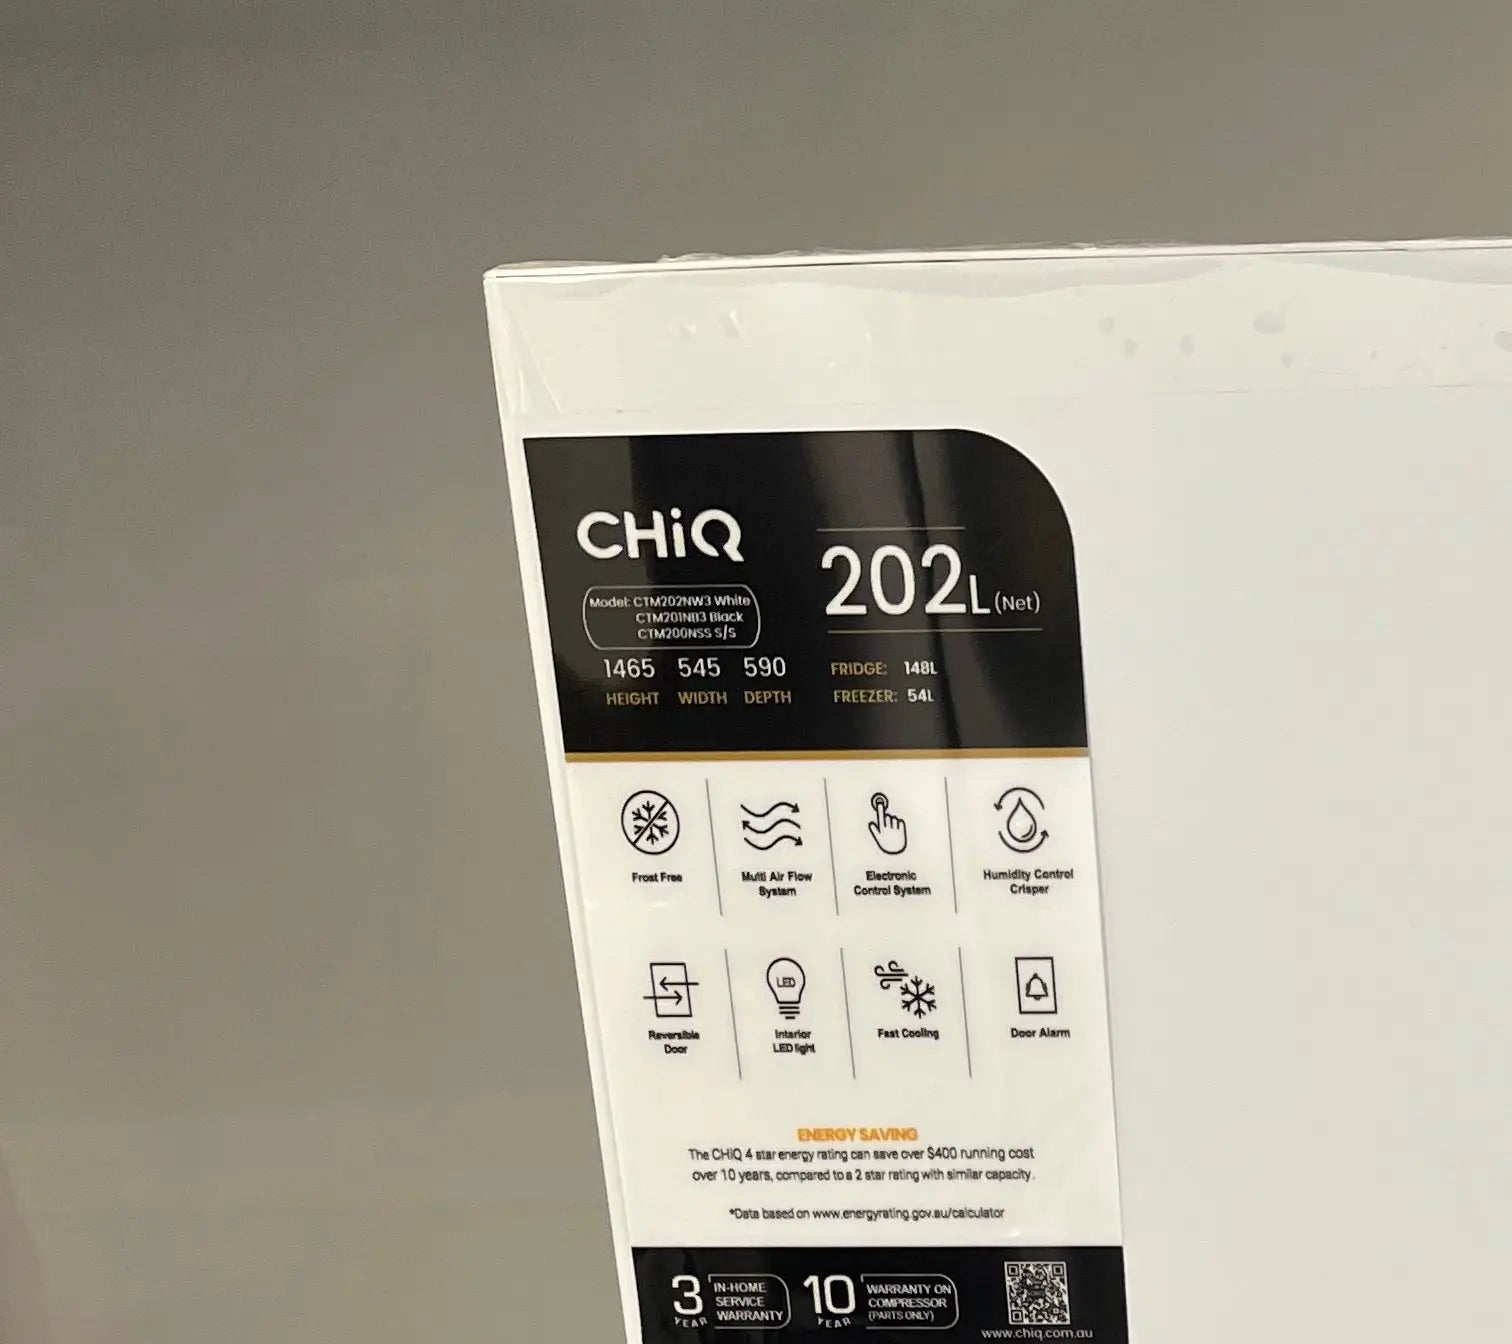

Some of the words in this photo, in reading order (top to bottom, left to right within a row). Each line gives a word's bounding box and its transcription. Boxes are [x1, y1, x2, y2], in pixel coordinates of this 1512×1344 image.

[576, 508, 745, 563] CHiQ
[590, 596, 631, 608] Model:
[633, 595, 711, 608] CTM202NW3
[714, 595, 751, 607] White
[994, 590, 1041, 615] (Net)
[709, 611, 744, 623] Black
[714, 624, 737, 641] S/S
[604, 658, 655, 679] 1465
[678, 657, 721, 678] 545
[743, 656, 786, 677] 590
[831, 661, 888, 676] FRIDGE:
[904, 660, 938, 676] 148L
[606, 691, 660, 705] HEIGHT
[678, 691, 728, 704] WIDTH
[744, 690, 792, 704] DEPTH
[834, 689, 898, 703] FREEZER:
[907, 688, 935, 703] 54L
[632, 872, 659, 883] Frost
[660, 872, 683, 883] Free
[741, 871, 767, 882] Multi
[769, 871, 785, 882] Air
[788, 870, 813, 882] Flow
[865, 870, 917, 882] Electronic
[983, 869, 1031, 882] Humidity
[1034, 868, 1074, 880] Control
[759, 885, 797, 898] System
[853, 885, 891, 896] Control
[893, 884, 931, 898] System
[1009, 883, 1050, 896] Crisper
[776, 976, 797, 988] LED
[648, 1029, 700, 1040] Reversible
[775, 1028, 811, 1039] Interior
[877, 1027, 900, 1039] Fast
[901, 1027, 940, 1040] Cooling
[1010, 1027, 1036, 1038] Door
[1038, 1027, 1071, 1039] Alarm
[664, 1044, 688, 1055] Door
[773, 1043, 794, 1054] LED
[794, 1043, 816, 1056] light
[797, 1127, 857, 1142] ENERGY
[860, 1127, 918, 1141] SAVING
[688, 1148, 710, 1161] The
[745, 1148, 753, 1160] 4
[755, 1149, 777, 1161] star
[778, 1150, 815, 1163] energy
[816, 1148, 848, 1162] rating
[850, 1150, 871, 1160] can
[873, 1150, 899, 1160] save
[901, 1149, 925, 1160] over
[926, 1146, 958, 1160] $400
[960, 1147, 1006, 1162] running
[1008, 1147, 1035, 1160] cost
[692, 1171, 718, 1182] over
[720, 1168, 736, 1181] 10
[738, 1170, 774, 1184] years,
[776, 1169, 830, 1183] compared
[832, 1169, 845, 1181] to
[846, 1171, 853, 1181] a
[855, 1168, 863, 1181] 2
[865, 1168, 886, 1181] star
[888, 1168, 920, 1183] rating
[921, 1168, 945, 1180] with
[947, 1168, 983, 1180] similar
[762, 1207, 795, 1220] based
[796, 1209, 810, 1220] on
[713, 1281, 767, 1293] IN-HOME
[866, 1284, 931, 1295] WARRANTY
[934, 1283, 952, 1294] ON
[671, 1274, 704, 1315] 3
[803, 1274, 856, 1315] 10
[715, 1296, 765, 1307] SERVICE
[868, 1297, 948, 1309] COMPRESSOR
[674, 1316, 708, 1328] YEAR
[716, 1310, 784, 1321] WARRANTY
[817, 1316, 852, 1328] YEAR
[868, 1310, 904, 1322] (PARTS
[905, 1310, 935, 1322] ONLY)
[981, 1327, 1094, 1342] www.chiq.com.au
